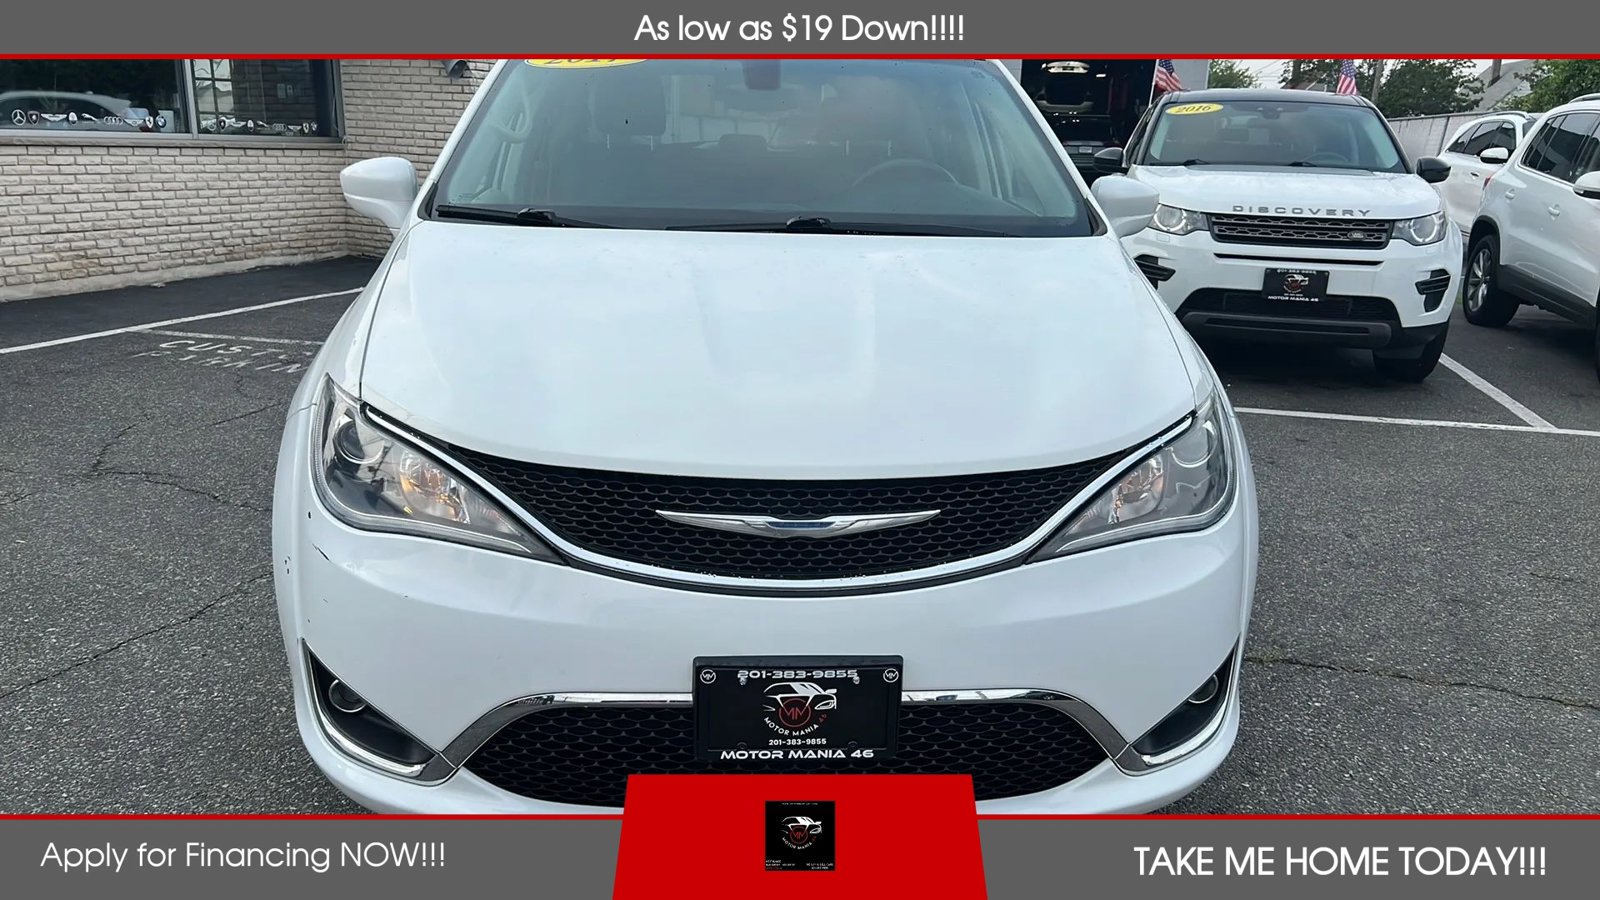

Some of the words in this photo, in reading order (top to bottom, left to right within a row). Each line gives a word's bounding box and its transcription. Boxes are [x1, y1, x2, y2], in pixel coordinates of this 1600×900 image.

[1175, 105, 1212, 113] 2016
[1232, 205, 1370, 216] DISCOVERY
[159, 340, 312, 358] CUST
[737, 669, 859, 681] 201-383-9855
[763, 716, 790, 736] MOTOR
[792, 723, 819, 736] MANIA
[768, 738, 827, 746] 201-383-9855
[720, 749, 784, 760] MOTOR
[788, 749, 846, 760] MANIA
[850, 749, 874, 758] 46
